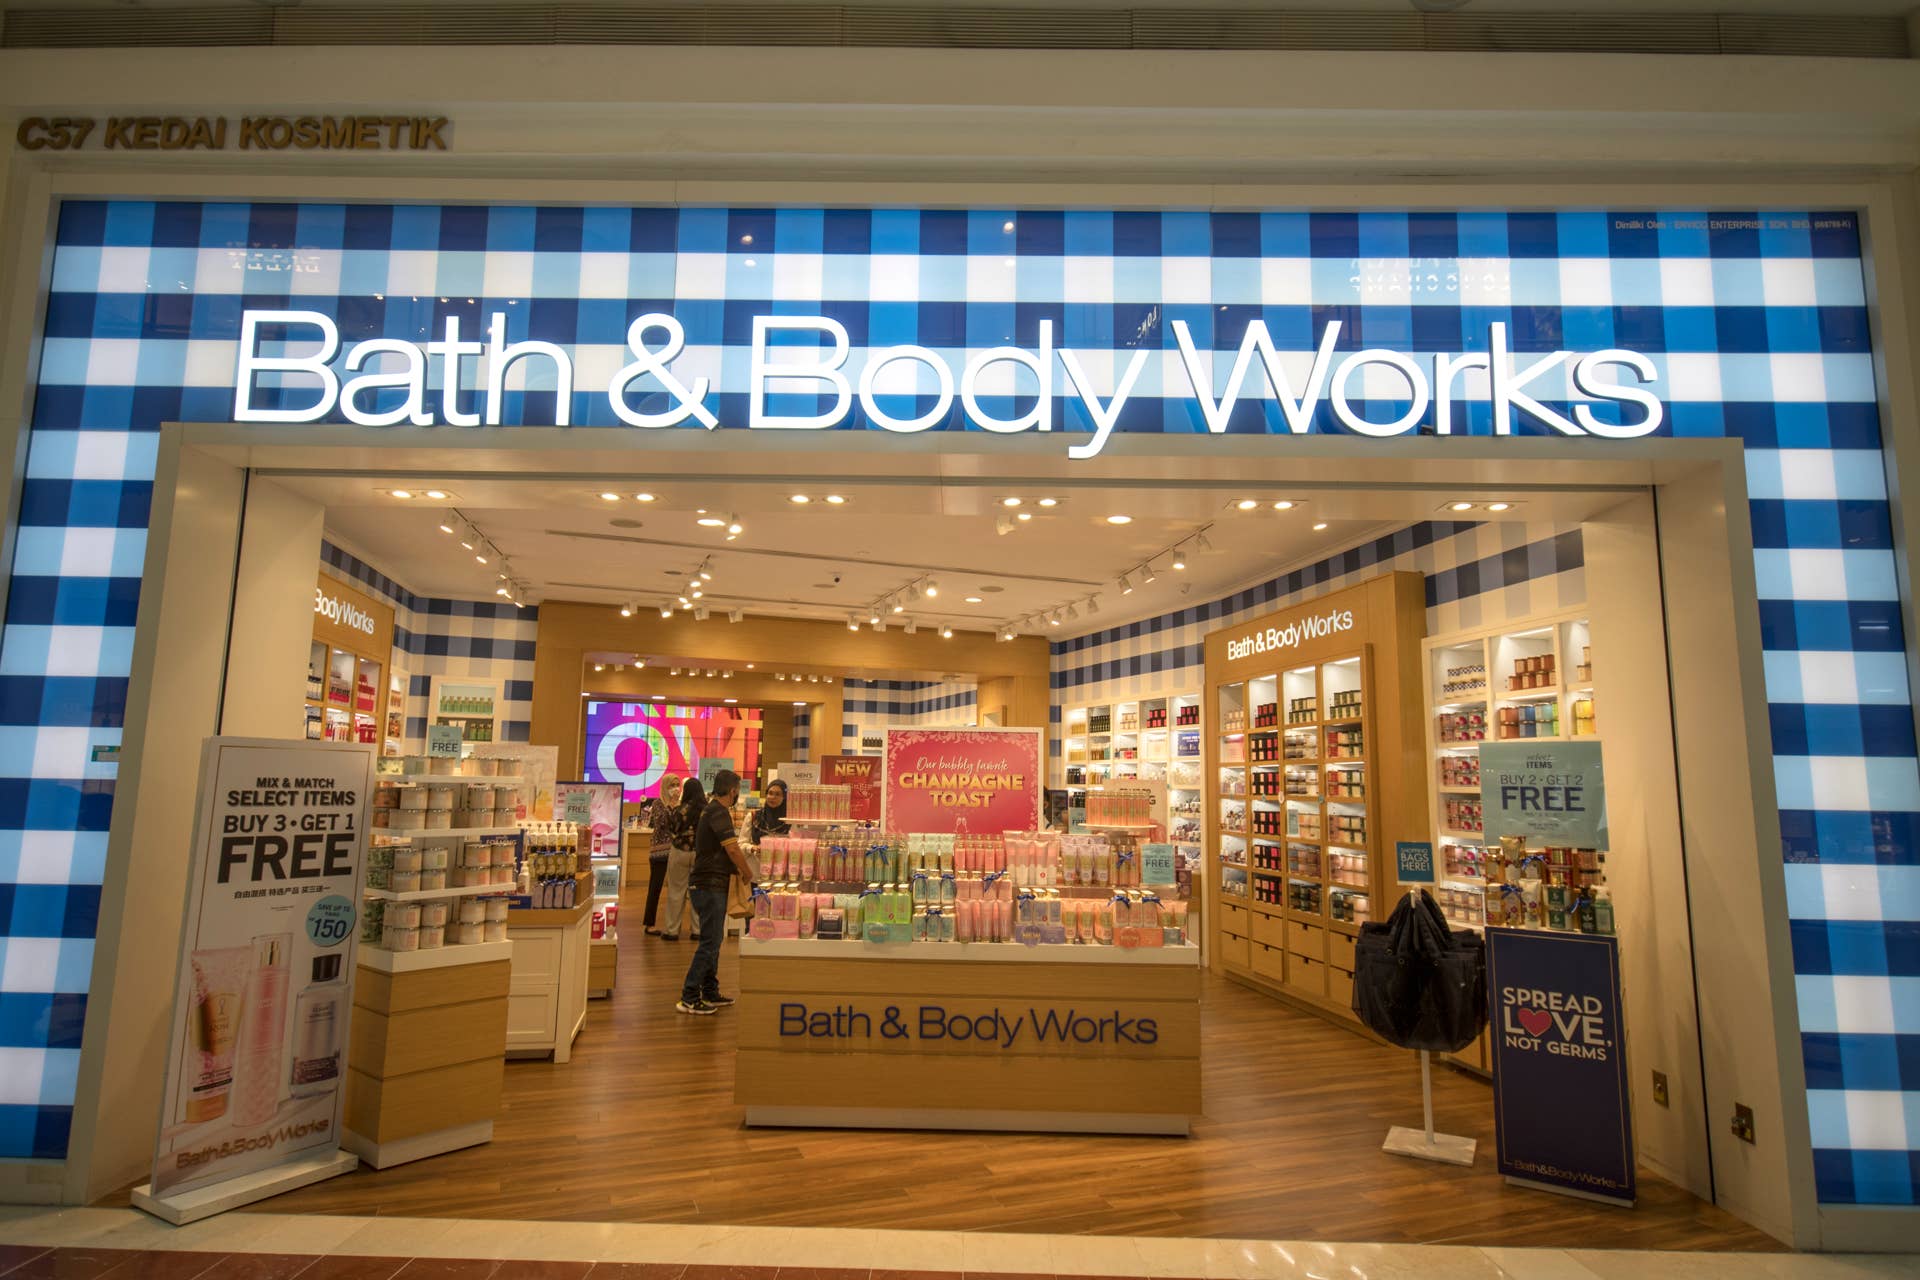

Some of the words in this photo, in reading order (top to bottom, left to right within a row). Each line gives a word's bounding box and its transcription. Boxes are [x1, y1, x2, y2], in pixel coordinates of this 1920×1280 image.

[17, 117, 95, 150] C57
[103, 117, 227, 149] KEDAI
[239, 116, 449, 150] KOSMETIK
[234, 310, 573, 427] Bath
[608, 312, 719, 431] &
[749, 315, 1150, 460] Body
[1170, 319, 1664, 439] Works
[342, 600, 375, 635] Works
[1227, 635, 1255, 661] Bath
[1255, 632, 1266, 653] &
[1266, 623, 1302, 650] Body
[1301, 609, 1353, 641] Works
[432, 742, 459, 752] FREE
[834, 763, 872, 777] NEW
[916, 756, 937, 771] Our
[938, 755, 974, 775] bubbly
[1526, 761, 1553, 769] ITEMS
[256, 777, 280, 789] MIX
[282, 777, 291, 788] &
[294, 778, 335, 789] MATCH
[899, 773, 1024, 791] CHAMPAGNE
[1500, 775, 1525, 785] BUY
[1528, 775, 1537, 785] 2
[1546, 774, 1572, 785] GET
[1575, 775, 1584, 785] 2
[227, 790, 299, 807] SELECT
[303, 791, 356, 806] ITEMS
[929, 790, 994, 808] TOAST
[1501, 786, 1586, 812] FREE
[567, 805, 588, 814] FREE
[223, 815, 269, 833] BUY
[273, 814, 286, 832] 3
[301, 814, 340, 831] GET
[345, 813, 354, 831] 1
[217, 833, 355, 884] FREE
[1145, 859, 1170, 868] FREE
[1401, 853, 1429, 863] BAGS
[314, 918, 347, 939] 150
[1502, 986, 1603, 1016] SPREAD
[780, 1004, 871, 1039] Bath
[880, 1006, 910, 1040] &
[919, 1006, 1023, 1048] Body
[1030, 1008, 1158, 1045] Works
[1505, 1035, 1542, 1052] NOT
[1546, 1040, 1607, 1062] GERMS
